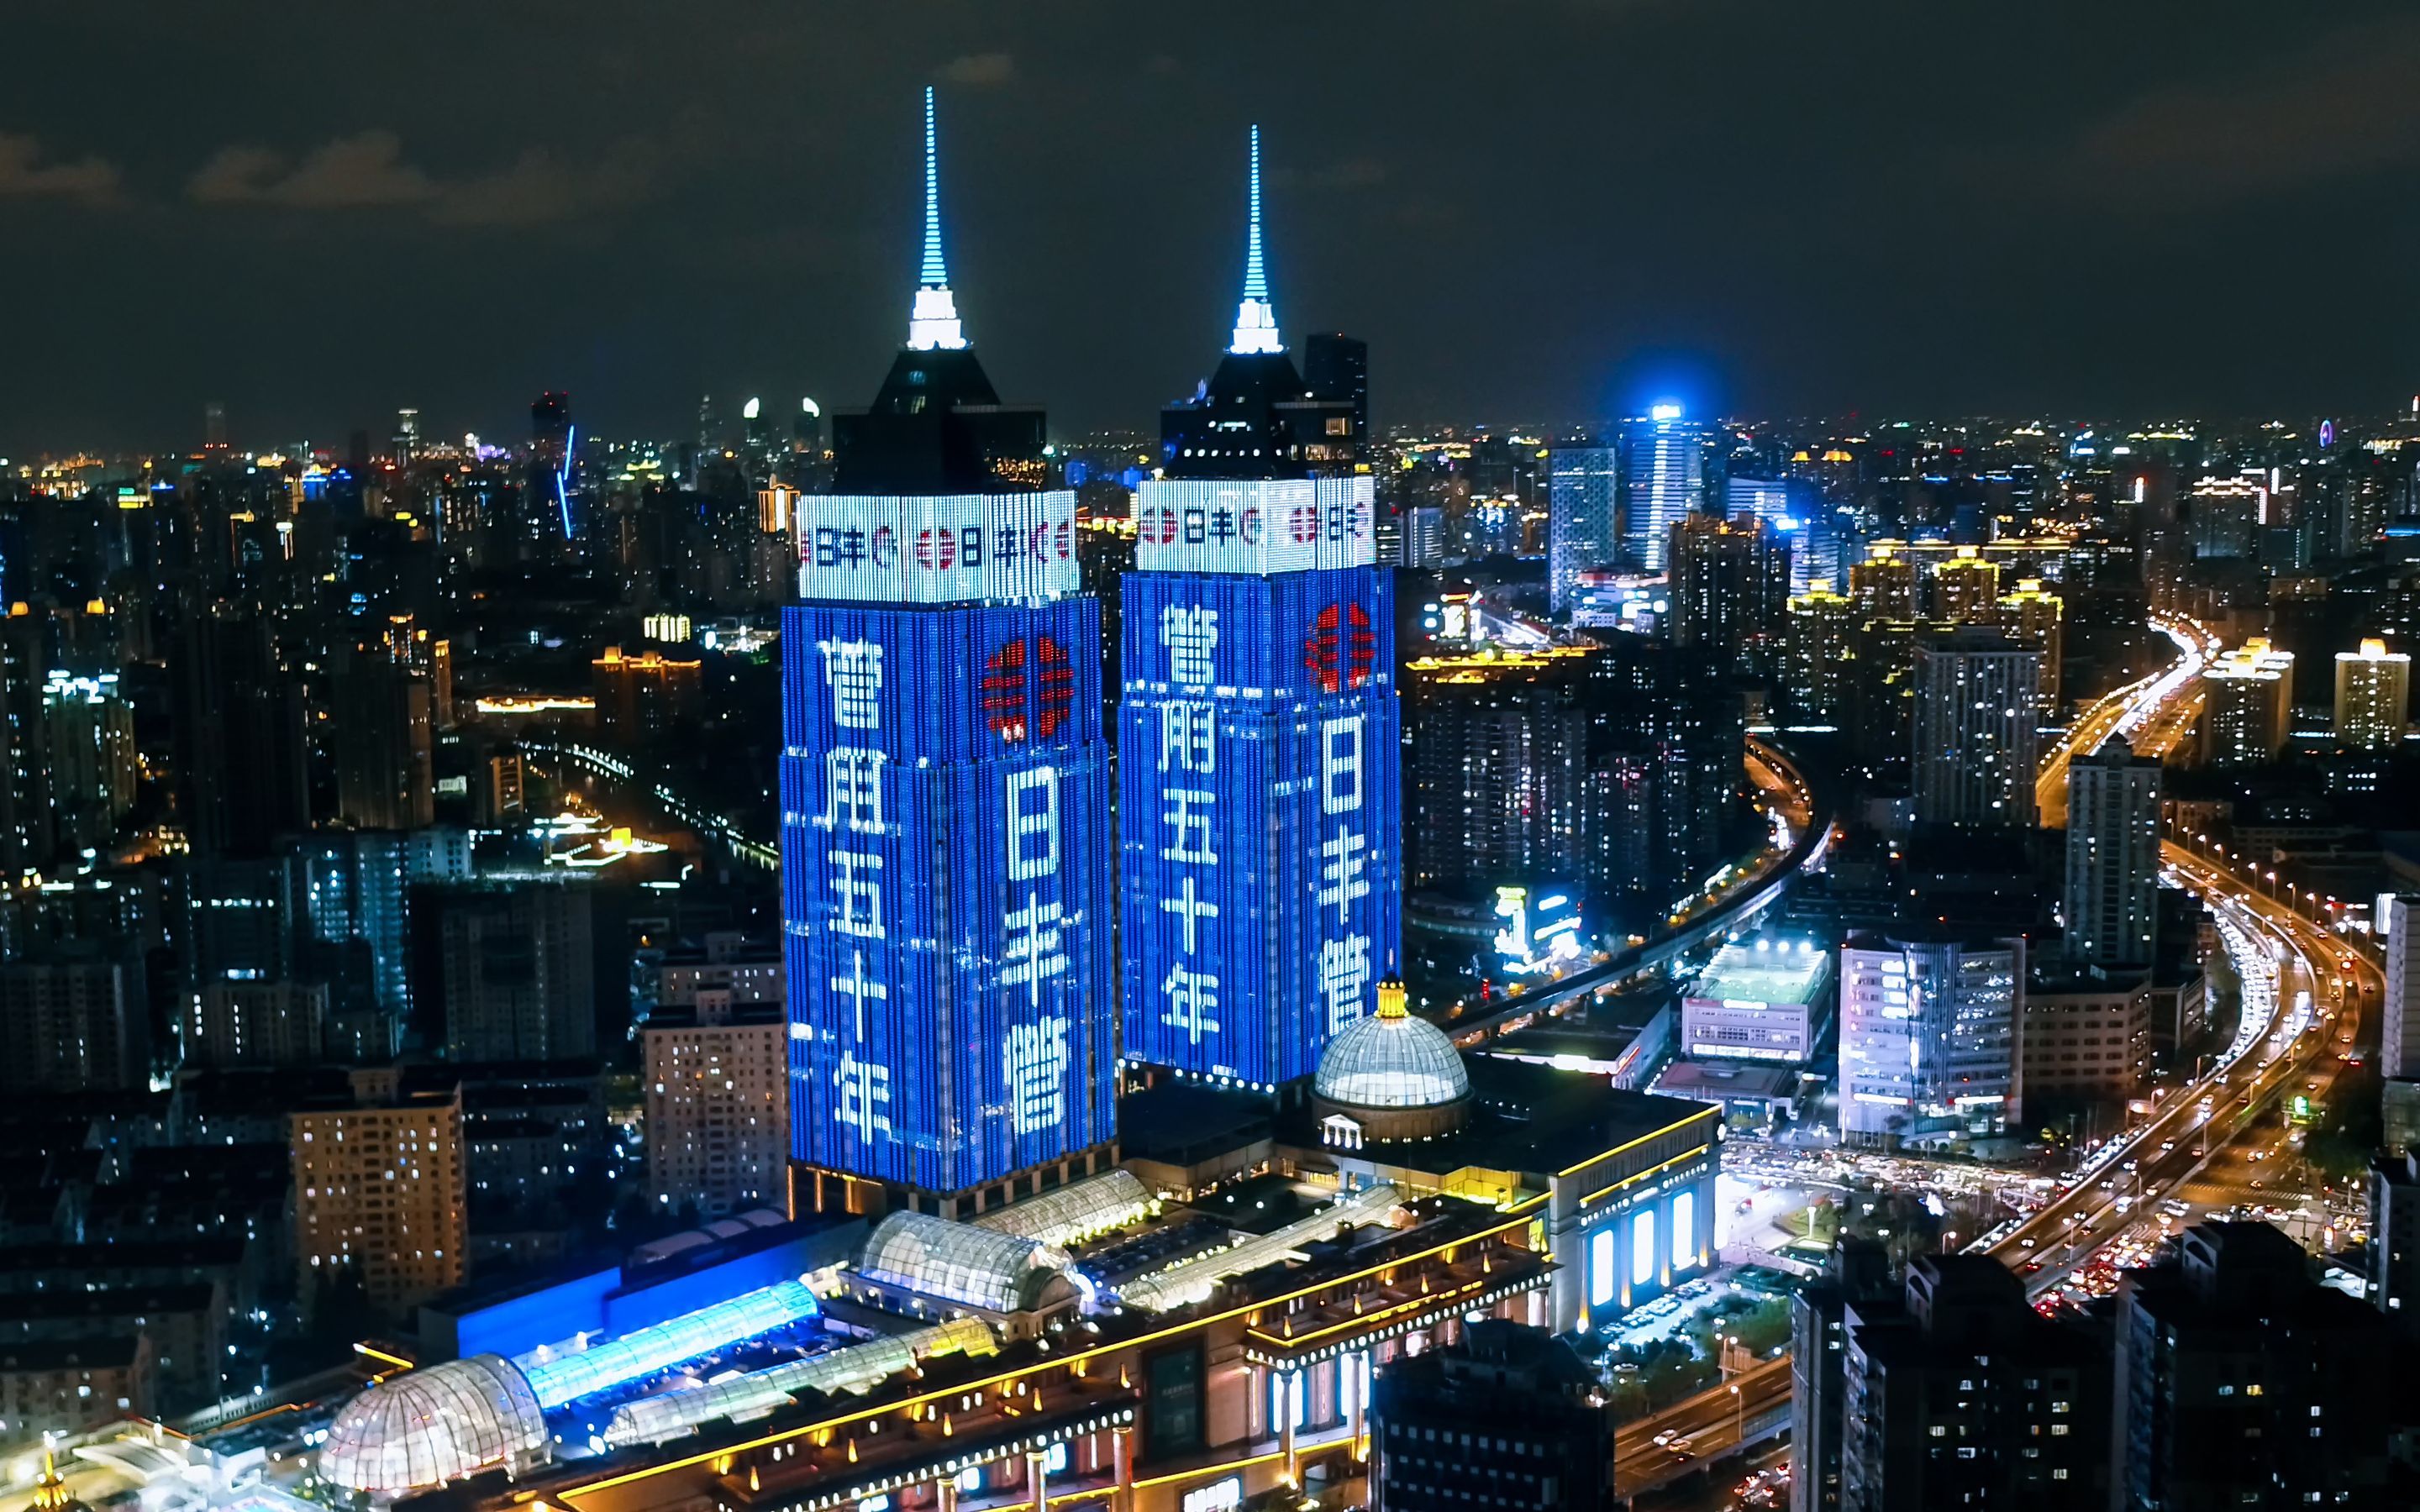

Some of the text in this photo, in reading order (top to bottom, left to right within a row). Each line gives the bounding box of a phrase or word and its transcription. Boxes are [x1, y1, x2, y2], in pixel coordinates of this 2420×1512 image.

[816, 636, 891, 1146] 管用五十年
[1003, 764, 1071, 1136] 日丰管
[1159, 603, 1220, 1045] 管用五十年
[1318, 716, 1370, 1037] 日丰管
